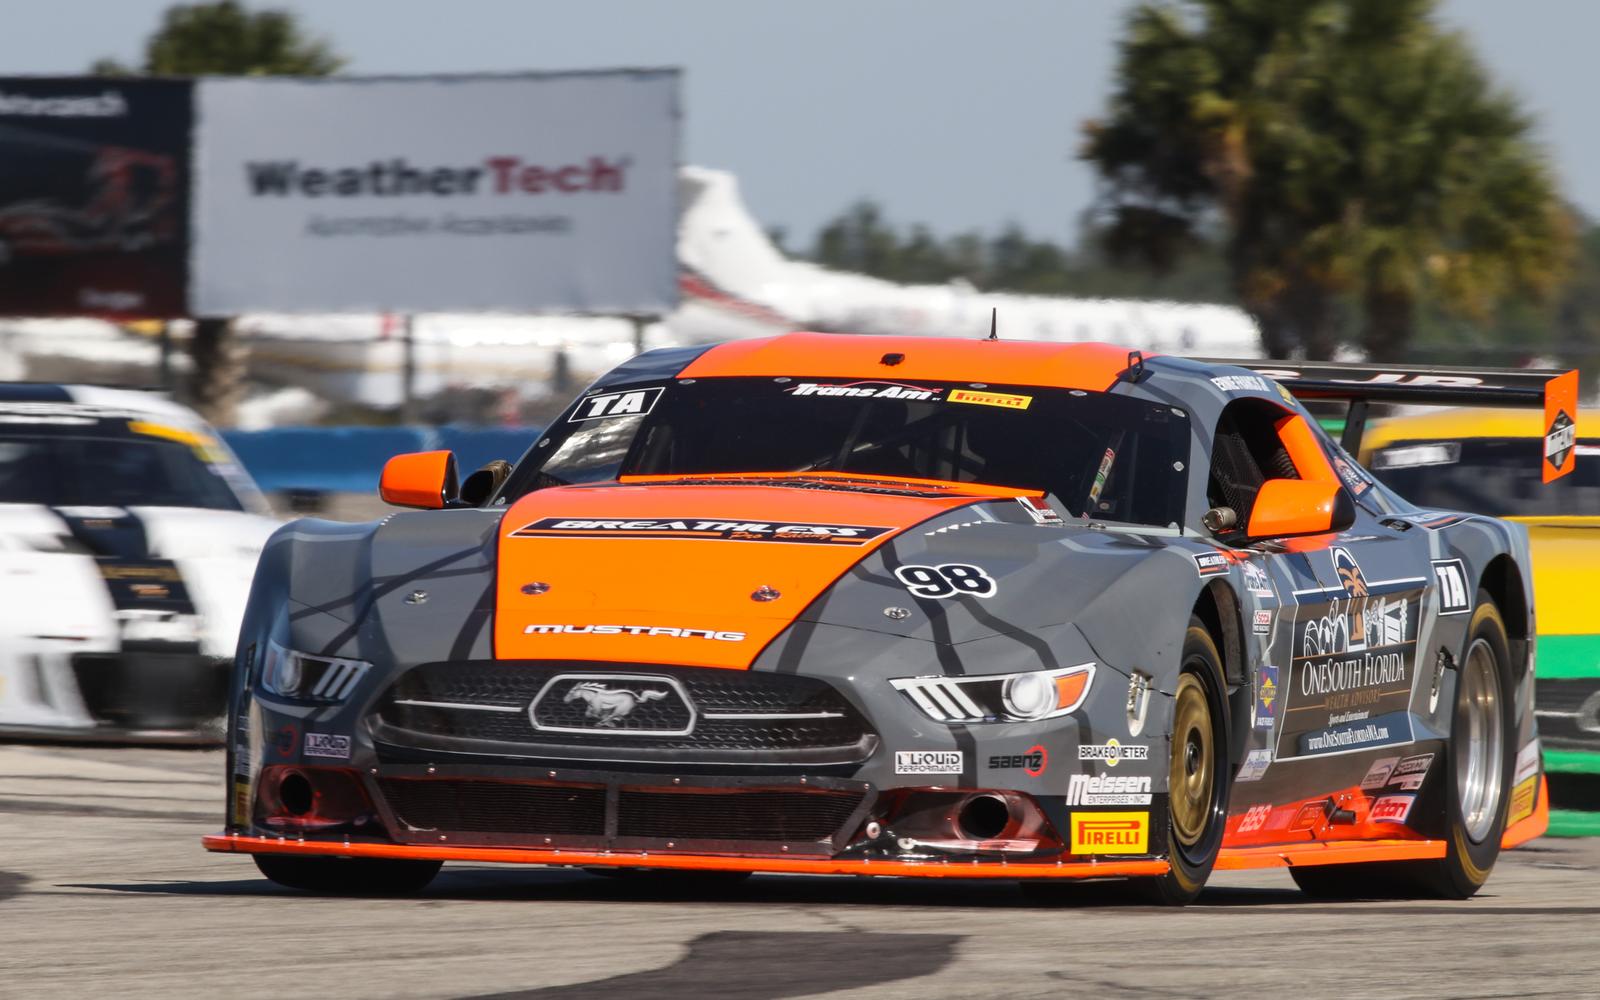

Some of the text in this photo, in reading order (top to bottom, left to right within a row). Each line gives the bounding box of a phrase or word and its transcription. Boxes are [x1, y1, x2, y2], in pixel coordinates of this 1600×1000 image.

[243, 154, 627, 198] WeatherTech
[791, 383, 877, 397] Trans
[873, 386, 932, 400] Am
[955, 392, 1025, 406] PIRELLI
[587, 391, 646, 417] TA
[551, 519, 867, 536] BREATHLESS
[896, 564, 996, 598] 98
[1436, 565, 1466, 607] TA
[523, 624, 747, 641] MUSTANG
[988, 750, 1043, 771] saenz
[1066, 771, 1152, 806] Meissen
[1237, 804, 1273, 828] BBS
[1078, 821, 1140, 845] PIRELLI
